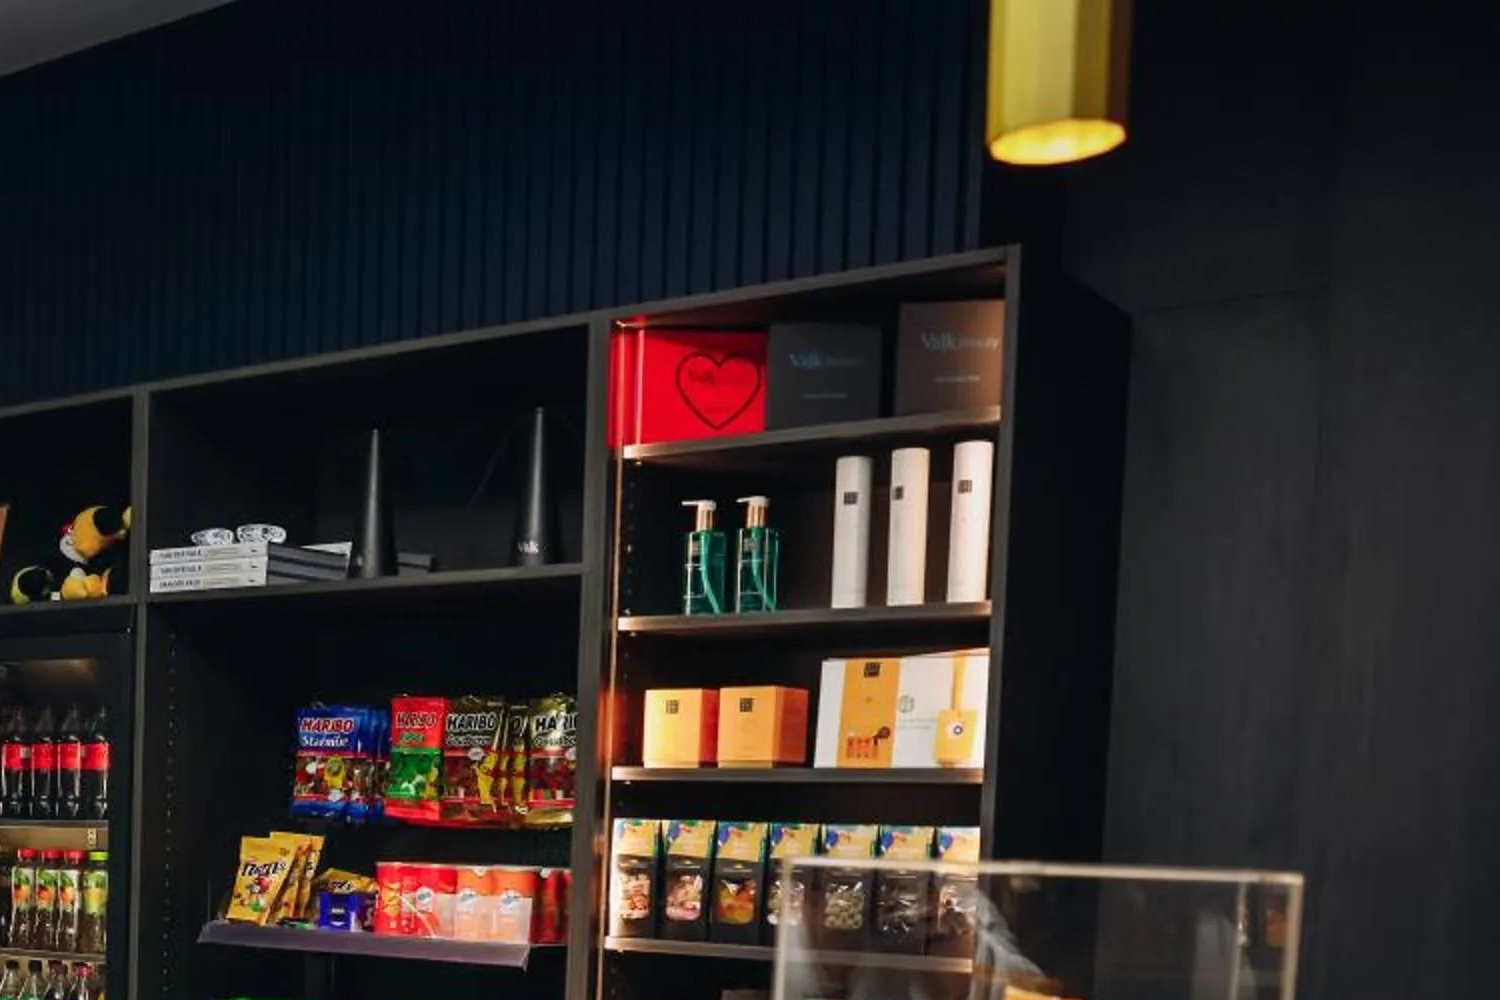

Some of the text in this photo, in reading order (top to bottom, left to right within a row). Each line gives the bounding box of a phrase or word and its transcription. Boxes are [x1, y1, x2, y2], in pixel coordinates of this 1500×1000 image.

[301, 717, 355, 734] HARIBO
[447, 711, 497, 733] HARIBO
[536, 712, 577, 731] HARI
